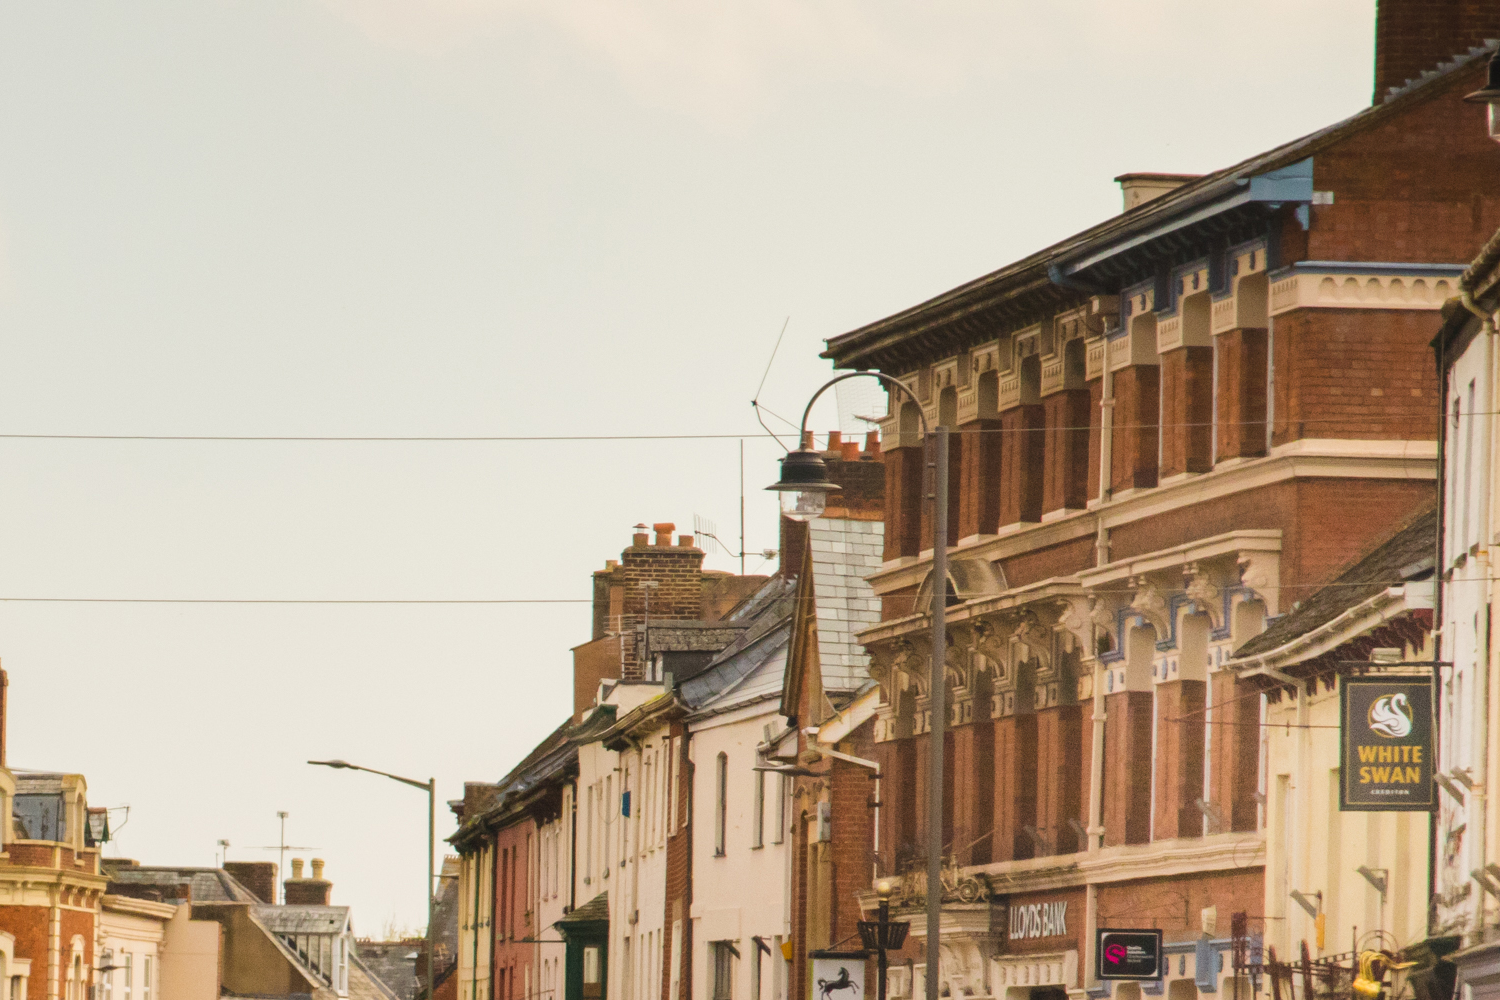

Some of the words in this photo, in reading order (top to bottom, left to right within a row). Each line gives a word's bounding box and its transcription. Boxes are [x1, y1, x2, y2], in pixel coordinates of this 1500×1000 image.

[1357, 745, 1423, 763] WHITE
[1359, 766, 1421, 784] SWAN
[1010, 903, 1042, 940] LLOYDS
[1043, 901, 1068, 937] BANK
